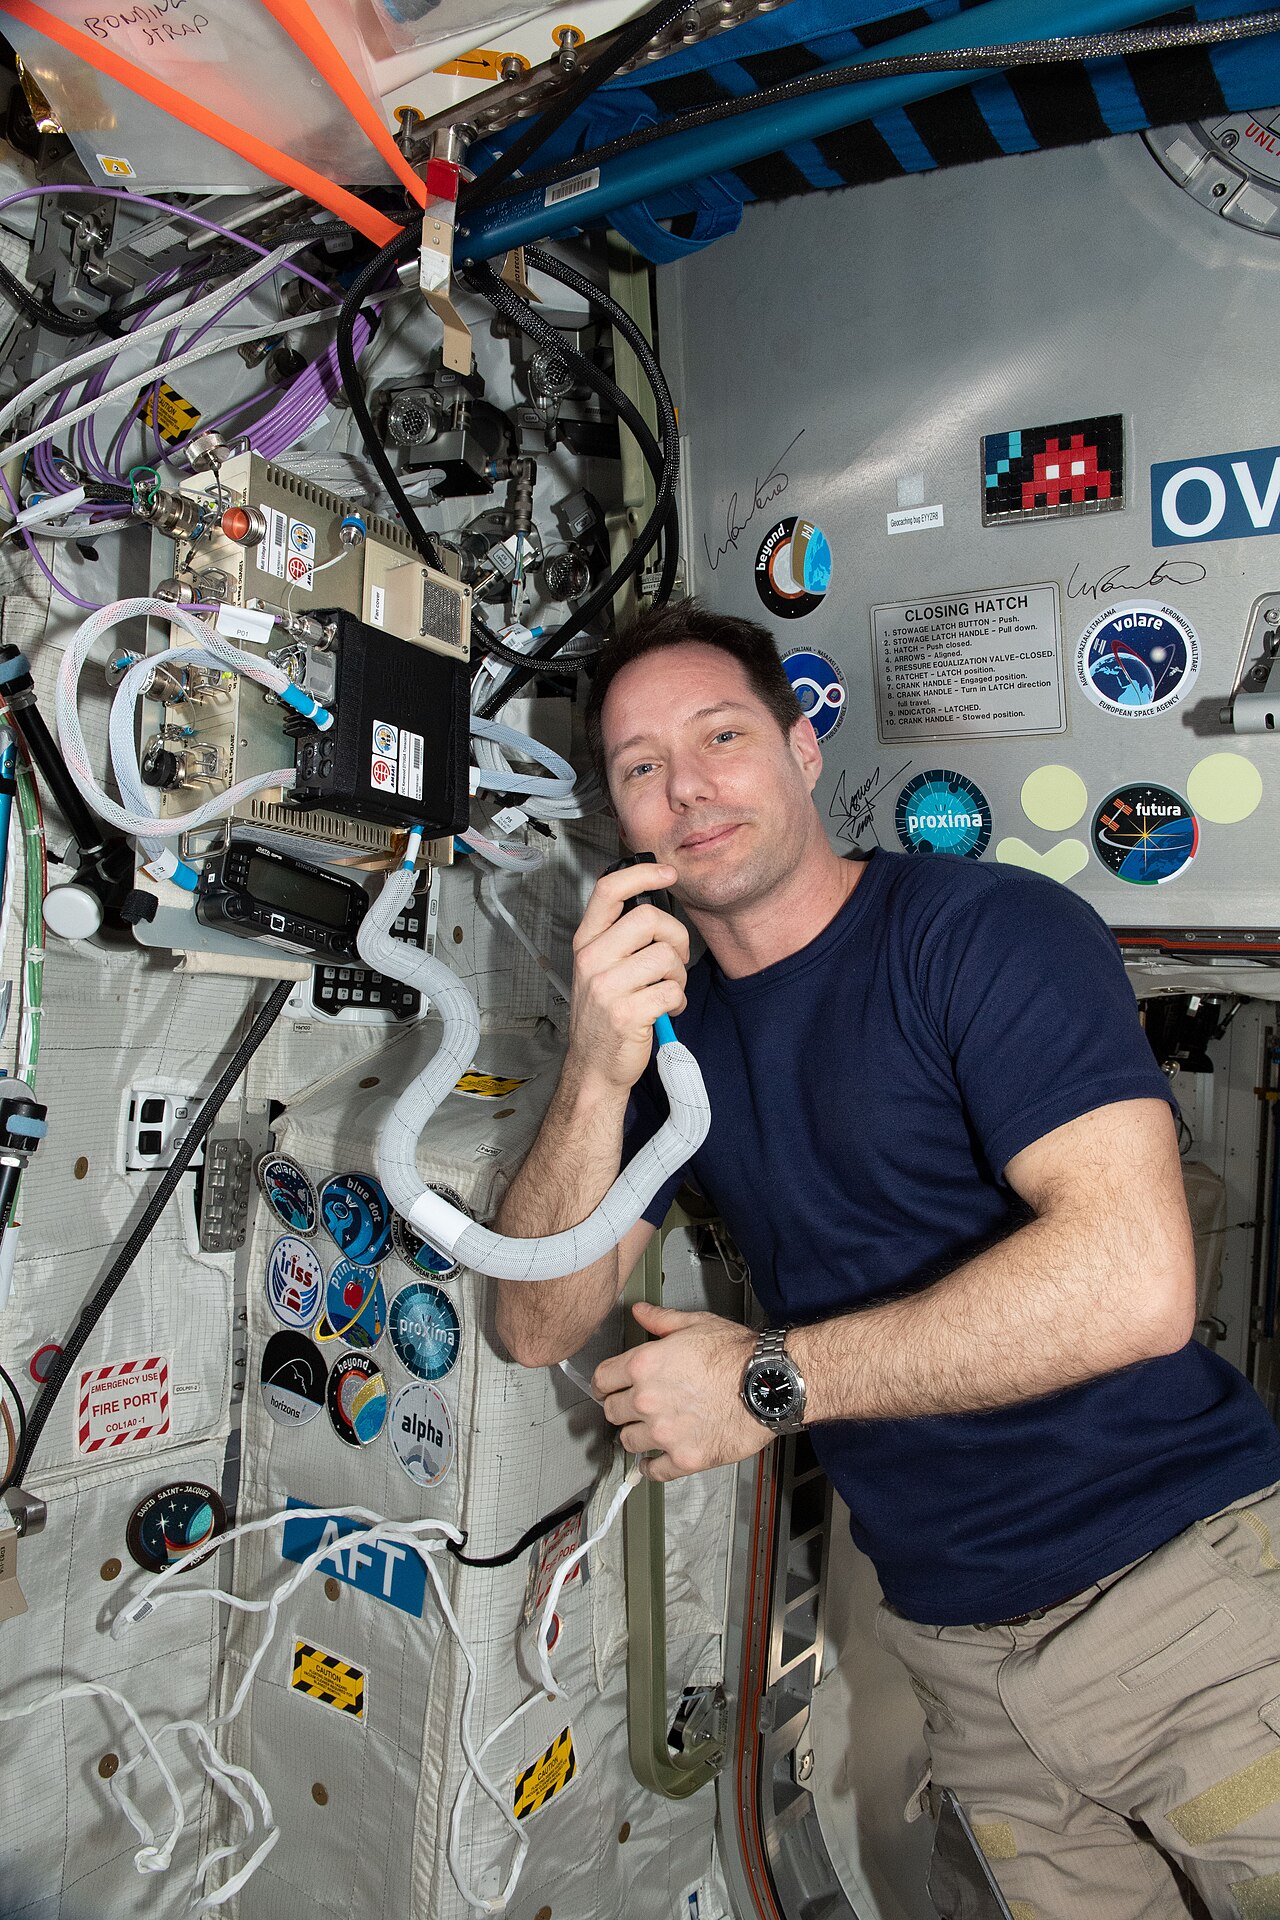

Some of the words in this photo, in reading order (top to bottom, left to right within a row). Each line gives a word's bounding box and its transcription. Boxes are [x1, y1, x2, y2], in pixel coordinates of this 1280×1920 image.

[143, 15, 208, 45] STRAP
[904, 602, 969, 622] CLOSING
[974, 596, 1028, 614] HATCH
[1091, 608, 1116, 630] ITALIANA
[892, 626, 928, 636] STOWAGE
[931, 623, 956, 632] LATCH
[958, 618, 990, 629] BUTTON
[998, 616, 1020, 624] Push.
[1113, 613, 1163, 632] volare
[893, 636, 929, 645] STOWAGE
[932, 632, 956, 641] LATCH
[958, 628, 989, 638] HANDLE
[998, 626, 1012, 634] Pull
[1015, 624, 1038, 632] down.
[1078, 630, 1092, 658] SPAZIALE
[1160, 606, 1195, 638] AERONAUTICA
[1190, 640, 1198, 672] MILITARE
[894, 646, 918, 654] HATCH
[926, 642, 943, 651] Push
[946, 640, 972, 648] closed.
[894, 654, 926, 662] ARROWS
[895, 662, 931, 672] PRESSURE
[933, 656, 988, 669] EQUALIZATION
[896, 672, 928, 681] RATCHET
[937, 669, 961, 677] LATCH
[964, 666, 995, 675] position.
[896, 681, 920, 690] CRANK
[923, 679, 951, 688] HANDLE
[960, 676, 992, 685] Engaged
[995, 673, 1028, 682] position.
[1078, 660, 1088, 686] AGENZIA
[897, 690, 921, 699] CRANK
[924, 688, 952, 696] HANDLE
[988, 683, 1014, 691] LATCH
[1018, 680, 1051, 689] direction
[898, 707, 936, 716] INDICATOR
[944, 704, 981, 713] LATCHED.
[1098, 700, 1132, 716] EUROPEAN
[1156, 695, 1180, 712] AGENCY
[898, 716, 922, 725] CRANK
[925, 714, 954, 723] HANDLE
[962, 713, 990, 721] Stowed
[1136, 802, 1182, 816] futura
[908, 810, 983, 832] proxima
[295, 862, 318, 874] KENWOOD
[271, 1163, 297, 1178] volare
[346, 1178, 370, 1200] blue
[368, 1202, 382, 1222] dot
[404, 1256, 430, 1278] EUROPEAN
[430, 1274, 446, 1282] SPACE
[400, 1319, 455, 1346] proxima
[337, 1359, 370, 1374] beyond
[91, 1376, 140, 1394] EMERGENCY
[142, 1373, 158, 1382] USE
[92, 1400, 120, 1418] FIRE
[123, 1392, 158, 1410] PORT
[270, 1395, 300, 1418] horizons
[402, 1413, 444, 1448] alpha
[138, 1499, 156, 1518] DAVID
[157, 1486, 211, 1500] SAINT-JACQUES
[316, 1520, 406, 1597] AFT
[316, 1665, 341, 1682] CAUTION
[538, 1756, 558, 1780] CAUTION
